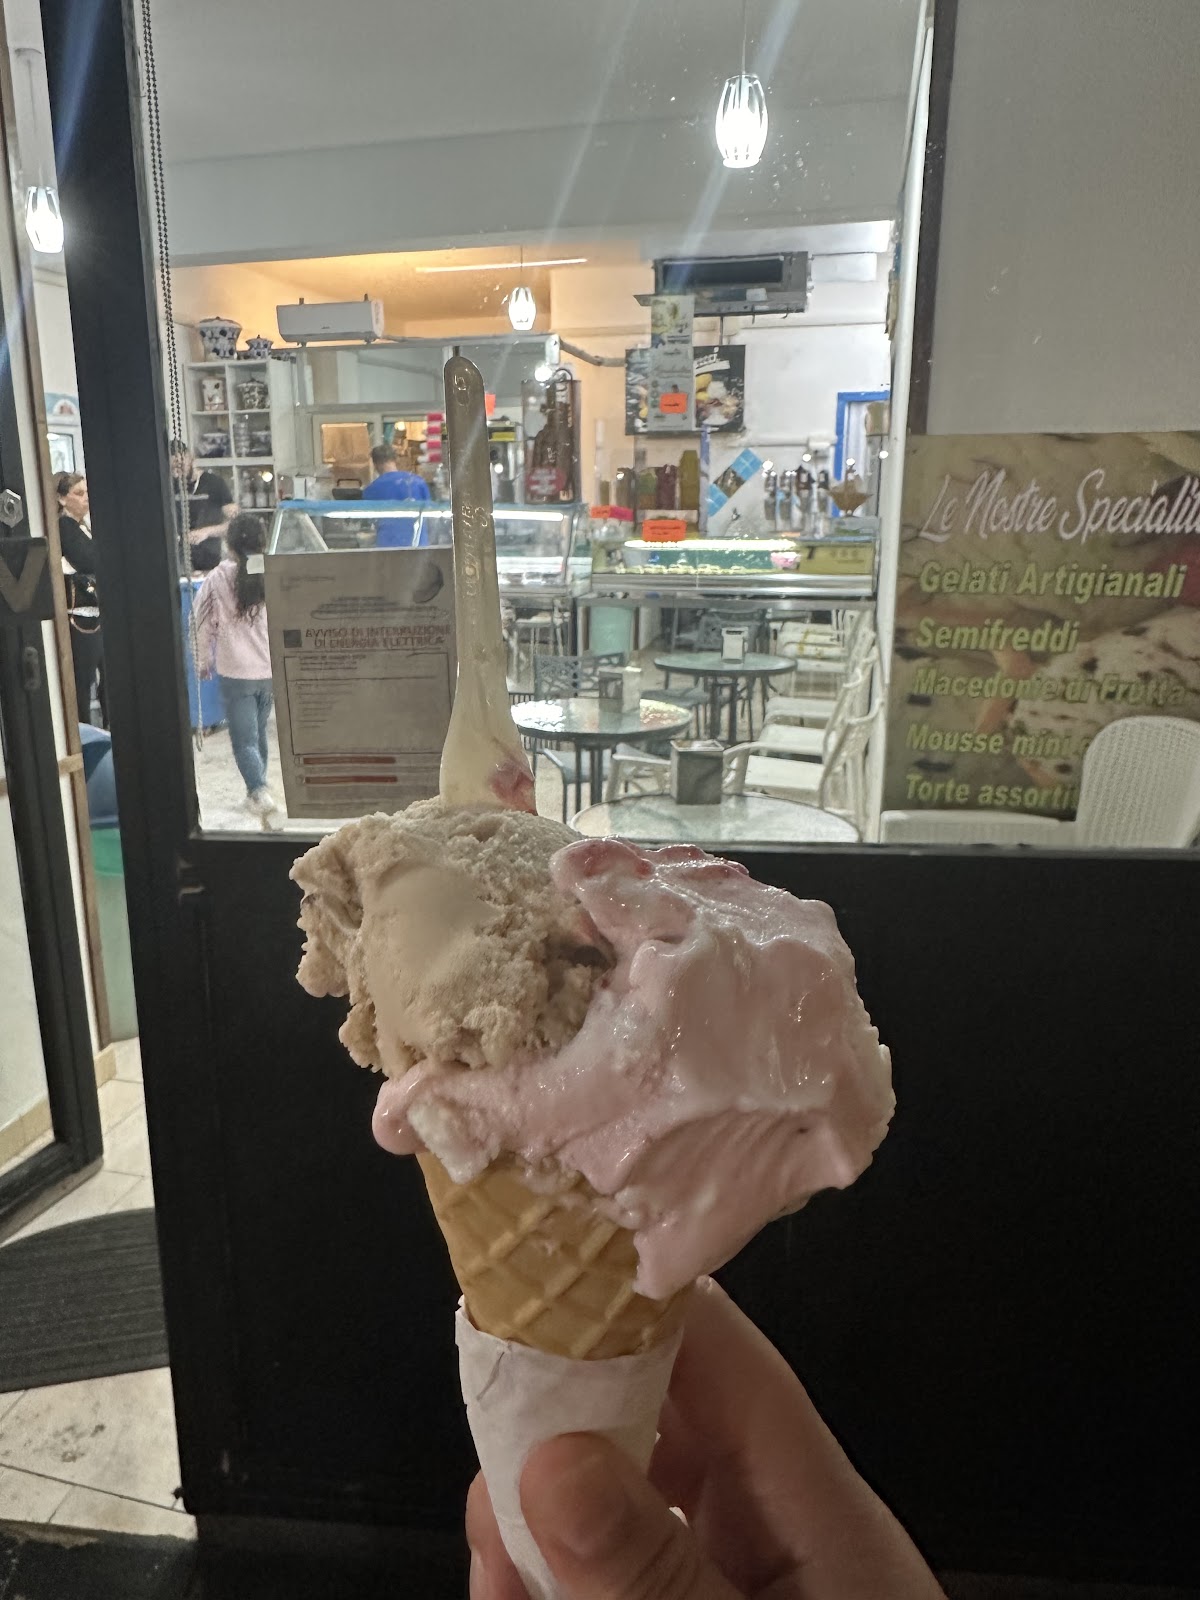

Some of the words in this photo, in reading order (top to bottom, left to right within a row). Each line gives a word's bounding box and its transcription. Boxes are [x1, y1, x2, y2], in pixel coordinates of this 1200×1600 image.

[918, 473, 956, 543] Le
[963, 467, 1057, 540] Nostre
[1058, 467, 1200, 546] Specialit
[918, 560, 1012, 594] Gelati
[1016, 561, 1188, 604] Artigianali
[916, 616, 1081, 651] Semifreddi
[905, 723, 1004, 754] Mousse
[905, 772, 971, 804] Torte
